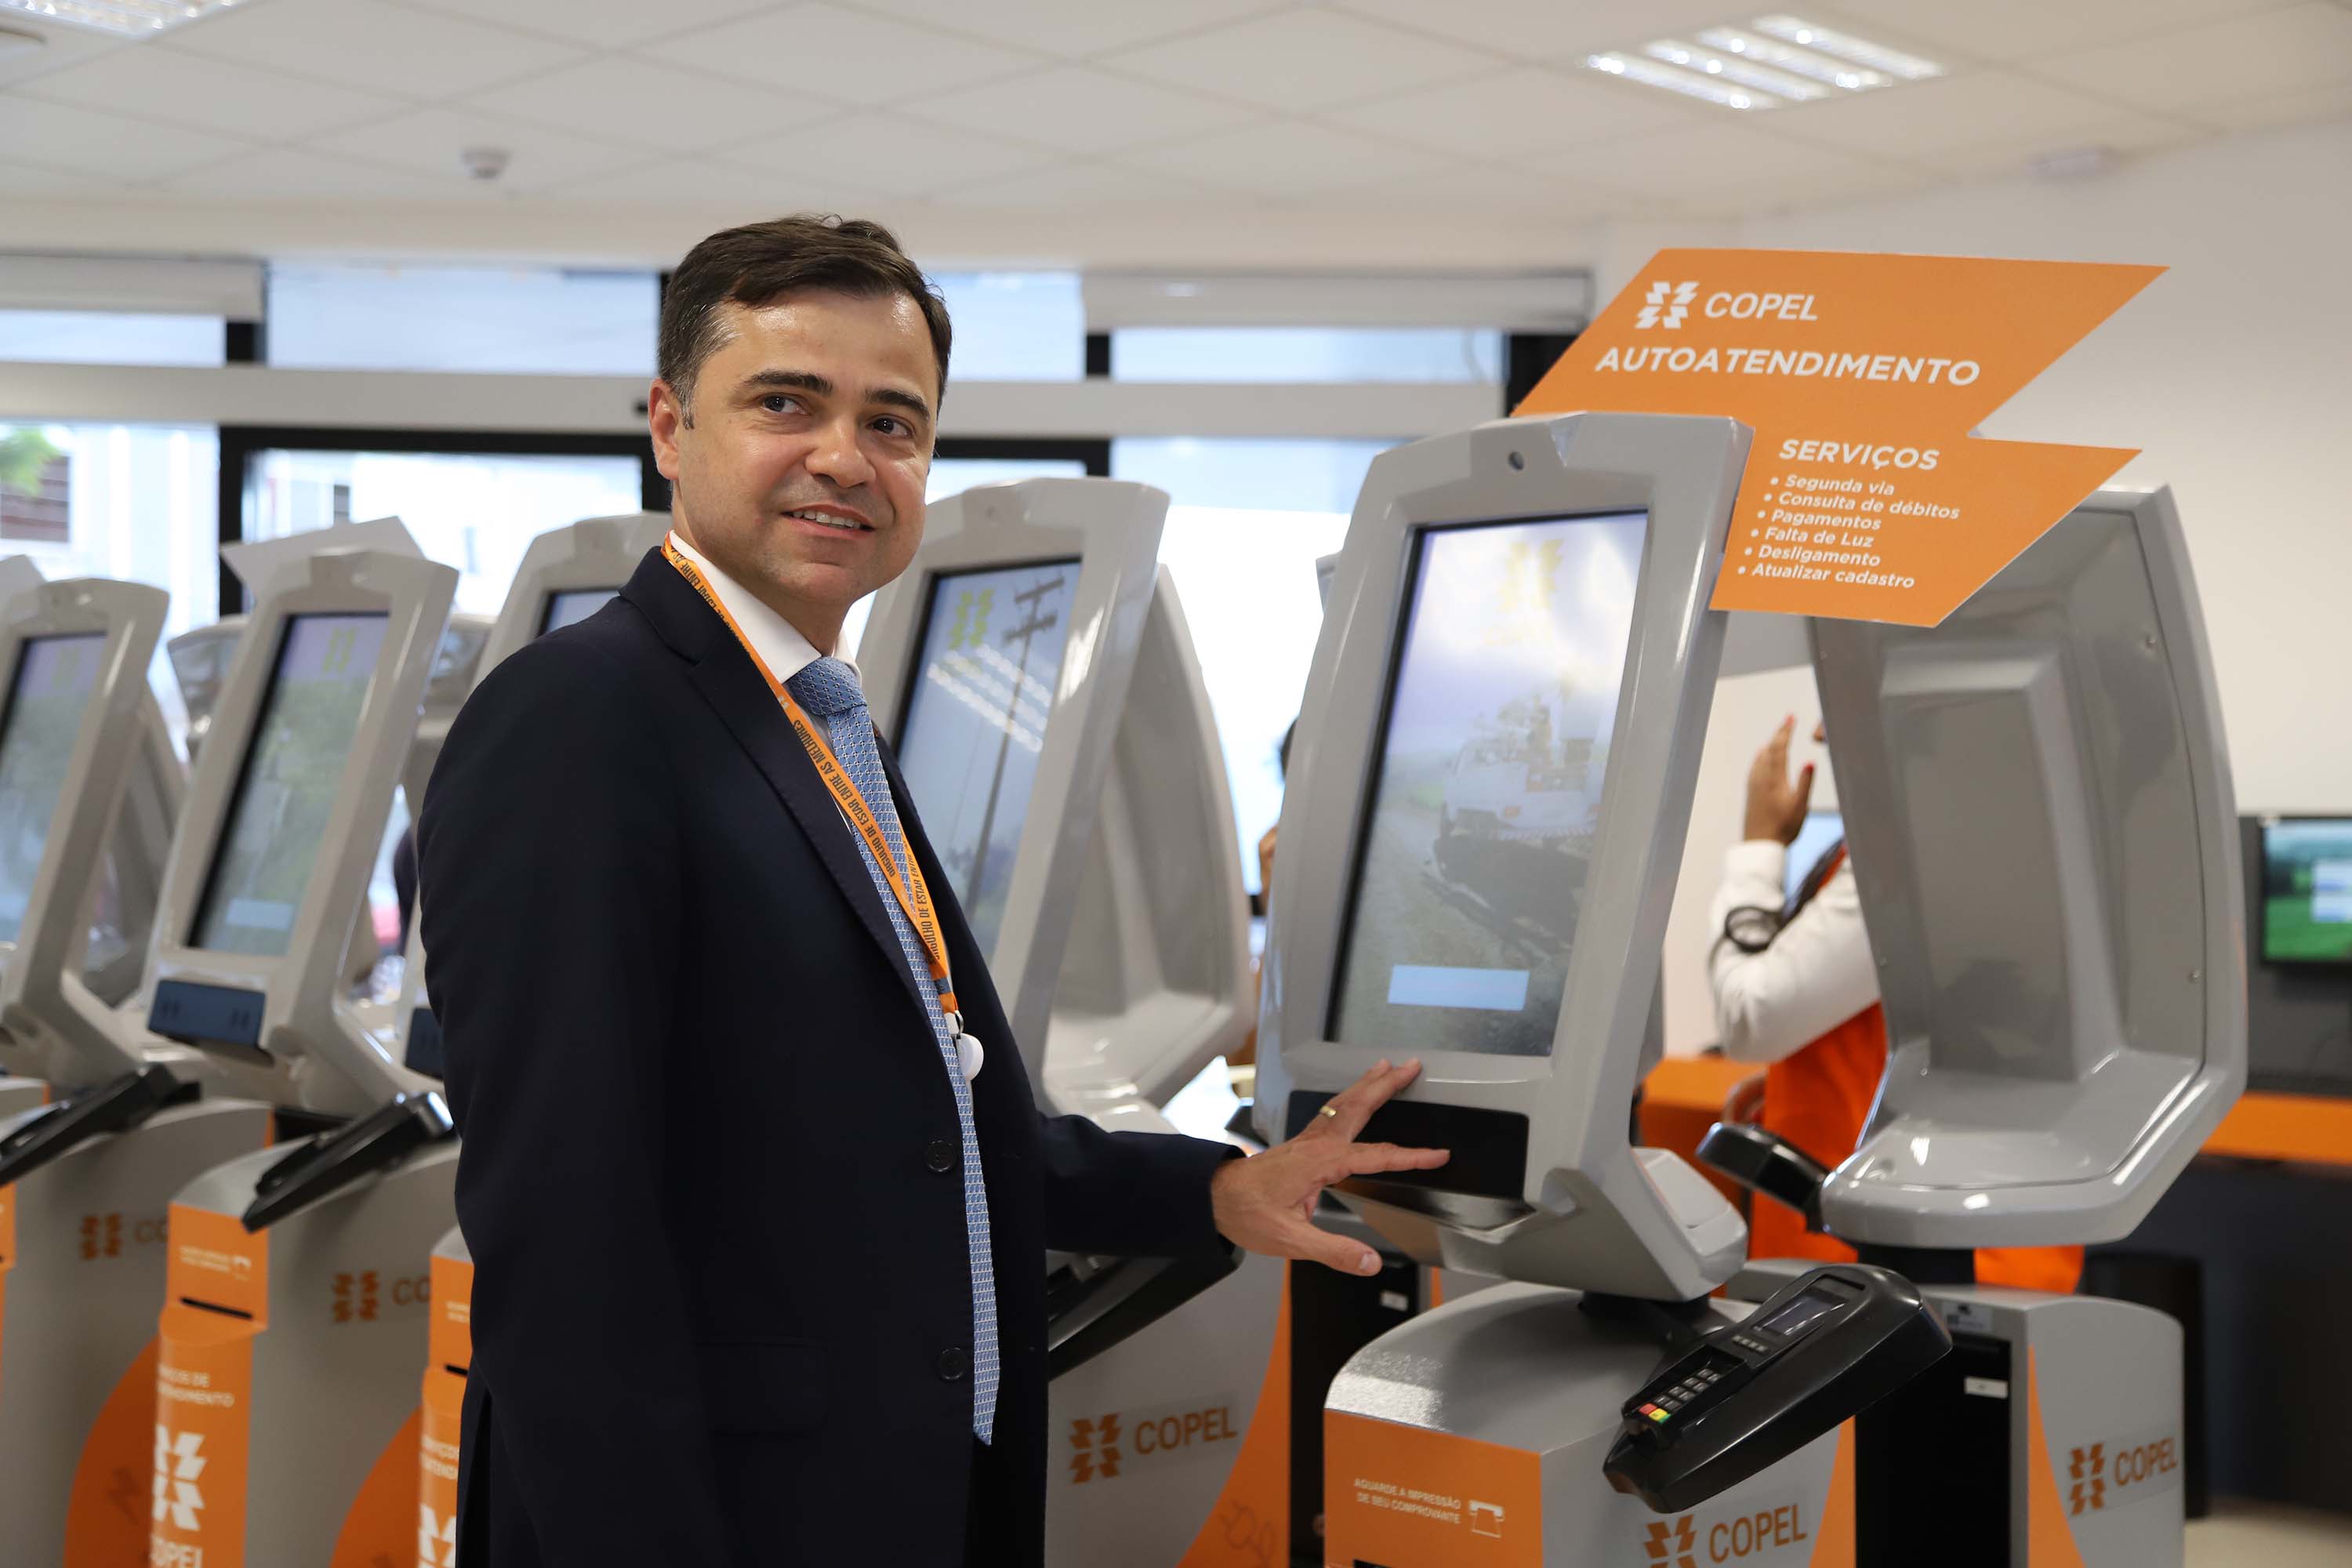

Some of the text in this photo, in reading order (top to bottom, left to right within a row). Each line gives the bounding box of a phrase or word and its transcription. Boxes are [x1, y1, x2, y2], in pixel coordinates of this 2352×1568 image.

[1704, 292, 1818, 321] COPEL
[1595, 347, 1980, 386] AUTOATENDIMENTO
[1779, 438, 1940, 470] SERVIÇOS
[1784, 474, 1895, 495] Segunda via
[1771, 509, 1882, 531] Pagamentos
[1778, 491, 1960, 520] Consulta de débitos
[1765, 527, 1875, 548] Falta de Luz
[1759, 545, 1881, 568] Desligamento
[1751, 562, 1915, 589] Atualizar cadastro
[793, 719, 896, 878] ORGULHO DE ESTAR ENTRE AS MELHORES
[914, 879, 927, 905] ESTAR
[919, 907, 931, 918] DE
[1133, 1406, 1238, 1456] COPEL
[2115, 1436, 2178, 1487] COPEL
[1708, 1503, 1807, 1565] COPEL
